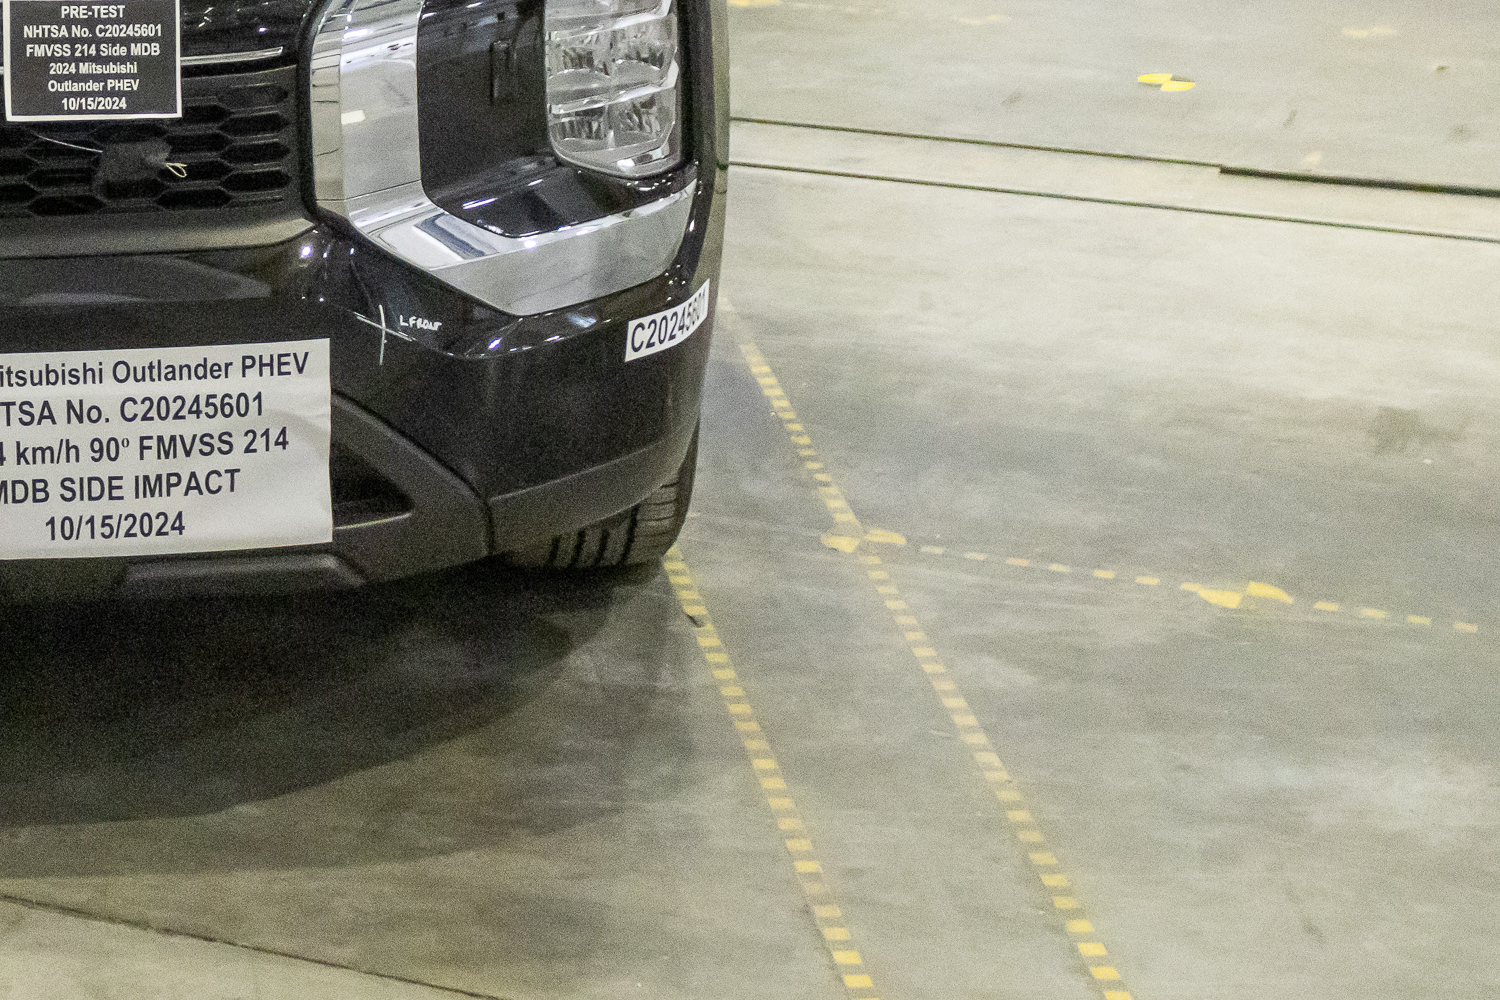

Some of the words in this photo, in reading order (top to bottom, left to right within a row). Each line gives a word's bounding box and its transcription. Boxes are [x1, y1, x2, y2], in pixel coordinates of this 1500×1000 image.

[61, 5, 125, 18] PRE-TEST
[24, 25, 68, 38] NHTSA
[72, 25, 92, 37] No.
[96, 24, 161, 37] C20245601
[27, 44, 71, 57] FMVSS
[75, 44, 96, 56] 214
[100, 44, 127, 56] Side
[131, 43, 160, 55] MDB
[50, 63, 76, 74] 2024
[79, 62, 137, 74] Mitsubishi
[48, 80, 105, 91] Outlander
[107, 79, 139, 90] PHEV
[62, 97, 127, 110] 10/15/2024
[113, 357, 233, 383] Outlander
[242, 352, 309, 377] PHEV
[67, 399, 109, 424] No.
[120, 392, 262, 422] C20245601
[16, 439, 79, 465] km/h
[140, 431, 233, 460] FMVSS
[244, 427, 288, 453] 214
[60, 476, 124, 502] SIDE
[135, 469, 240, 499] IMPACT
[46, 511, 185, 540] 10/15/2024
